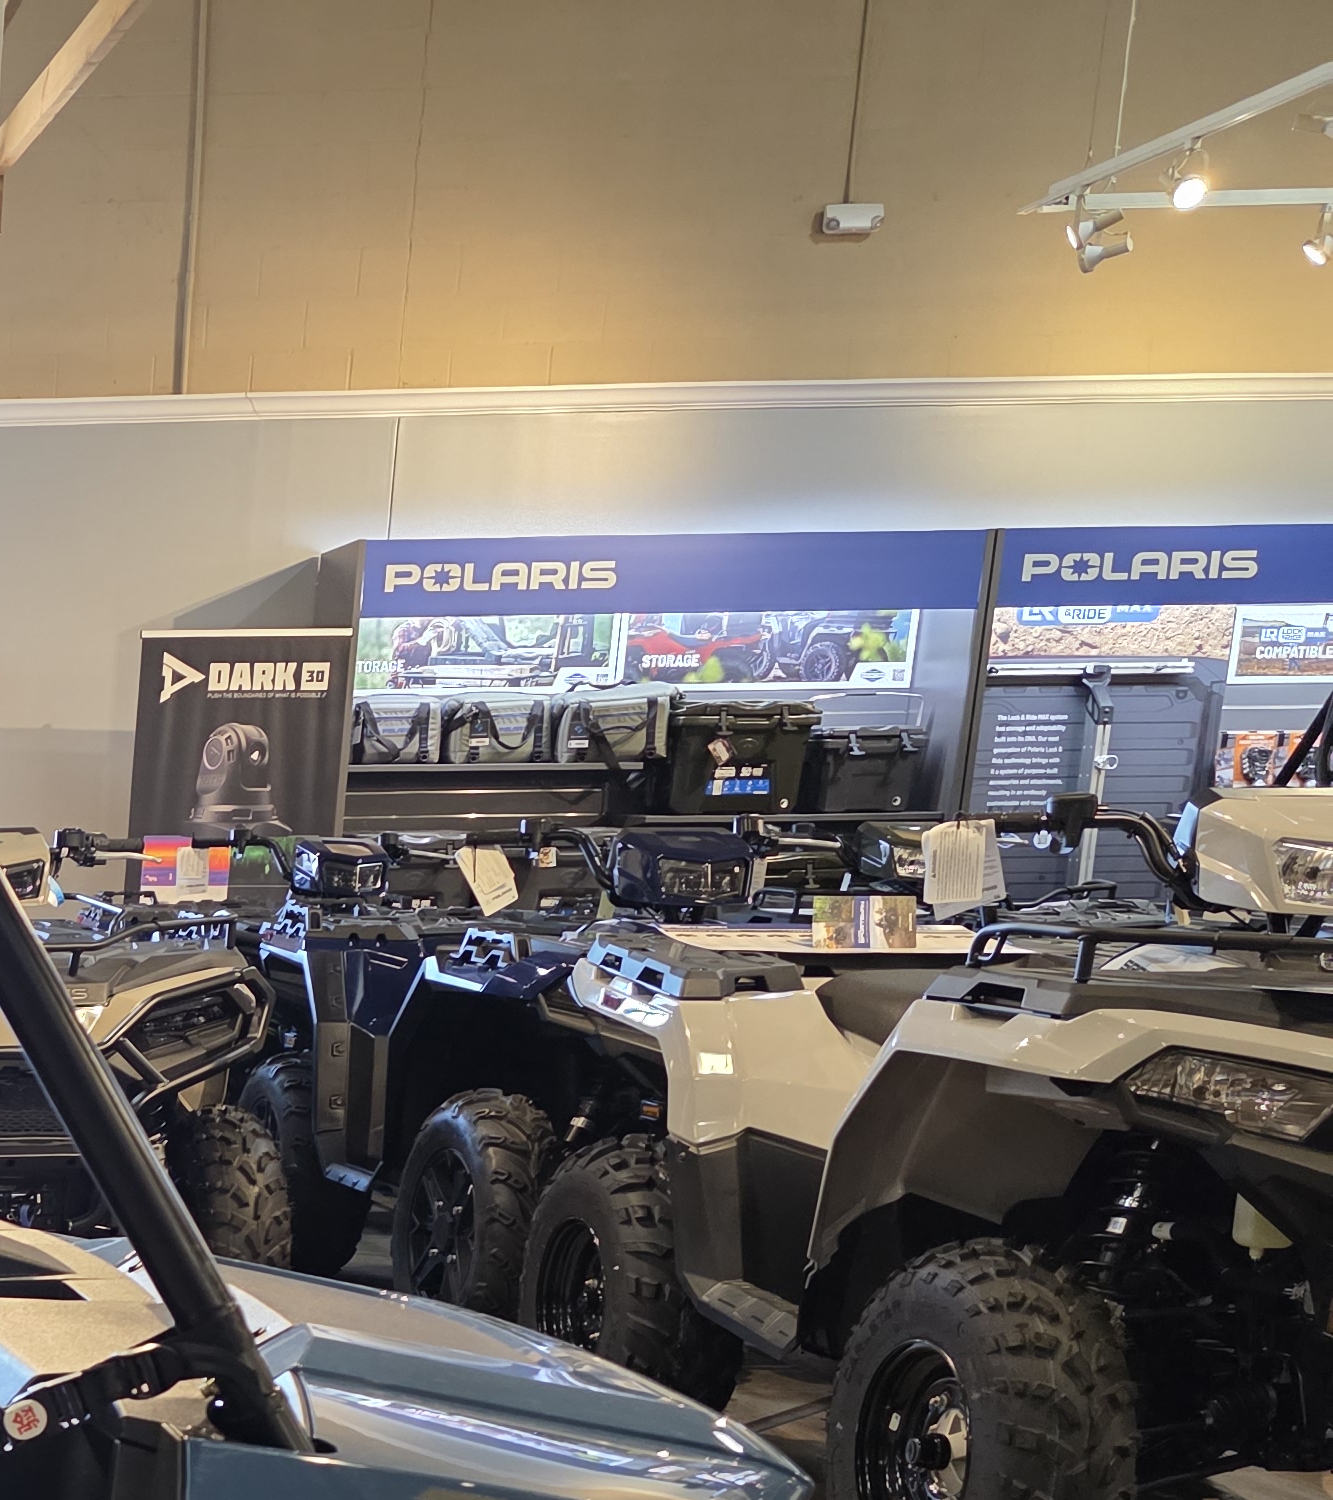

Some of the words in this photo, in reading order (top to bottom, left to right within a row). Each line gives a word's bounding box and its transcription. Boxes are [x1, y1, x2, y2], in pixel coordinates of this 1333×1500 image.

[1021, 549, 1259, 582] POLARIS
[384, 560, 618, 593] POLARIS
[641, 654, 700, 668] STORAGE
[1256, 646, 1333, 659] COMPATIBLE
[208, 663, 297, 691] DARK
[356, 660, 406, 674] TORAGE
